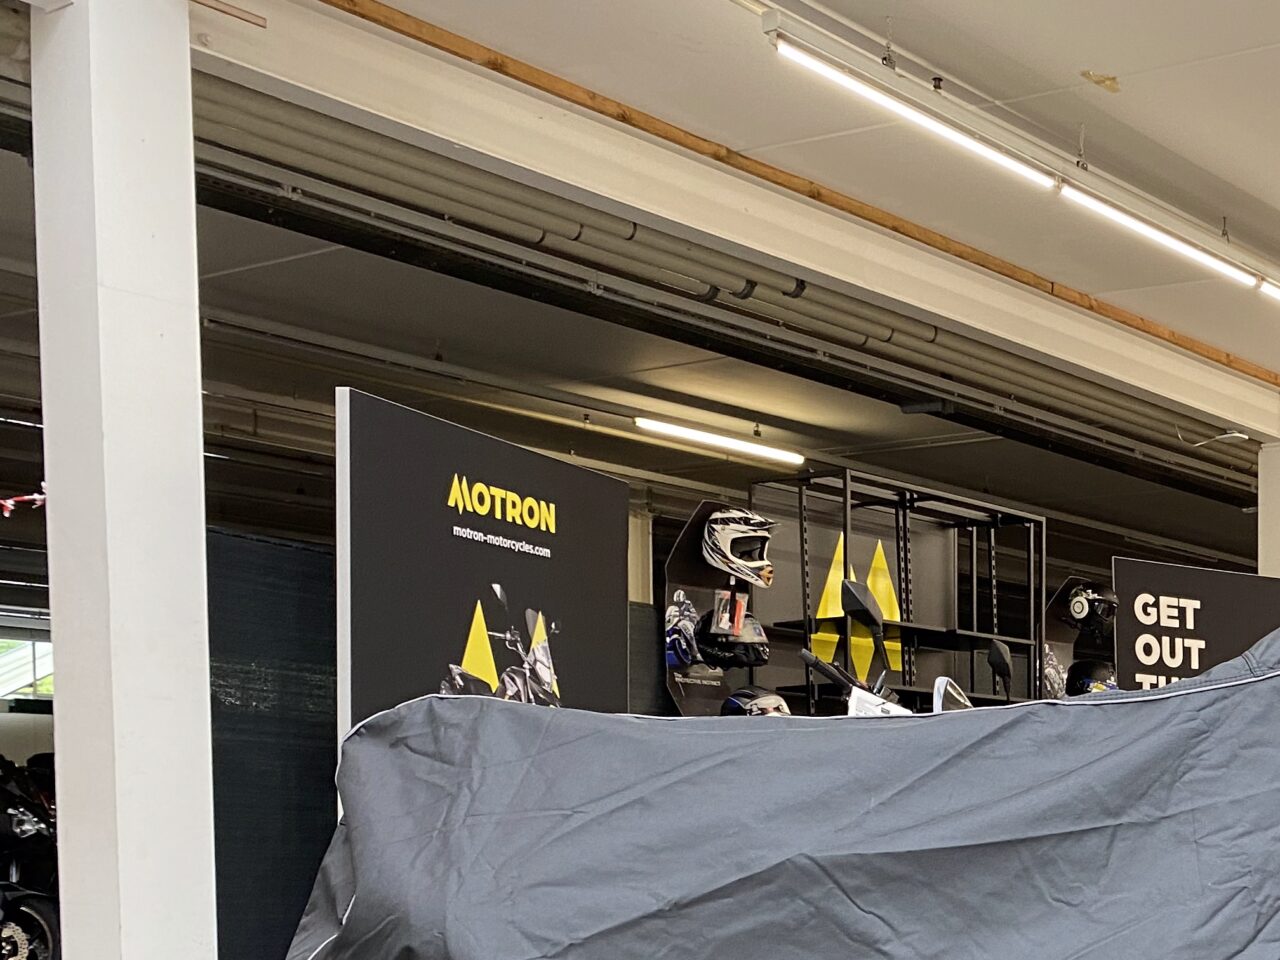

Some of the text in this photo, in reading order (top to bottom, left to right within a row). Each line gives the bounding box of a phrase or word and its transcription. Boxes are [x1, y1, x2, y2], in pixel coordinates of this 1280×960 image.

[447, 473, 556, 534] MOTRON
[453, 526, 551, 558] motron-motorcycles.com
[1134, 593, 1200, 630] GET
[1135, 633, 1205, 670] OUT
